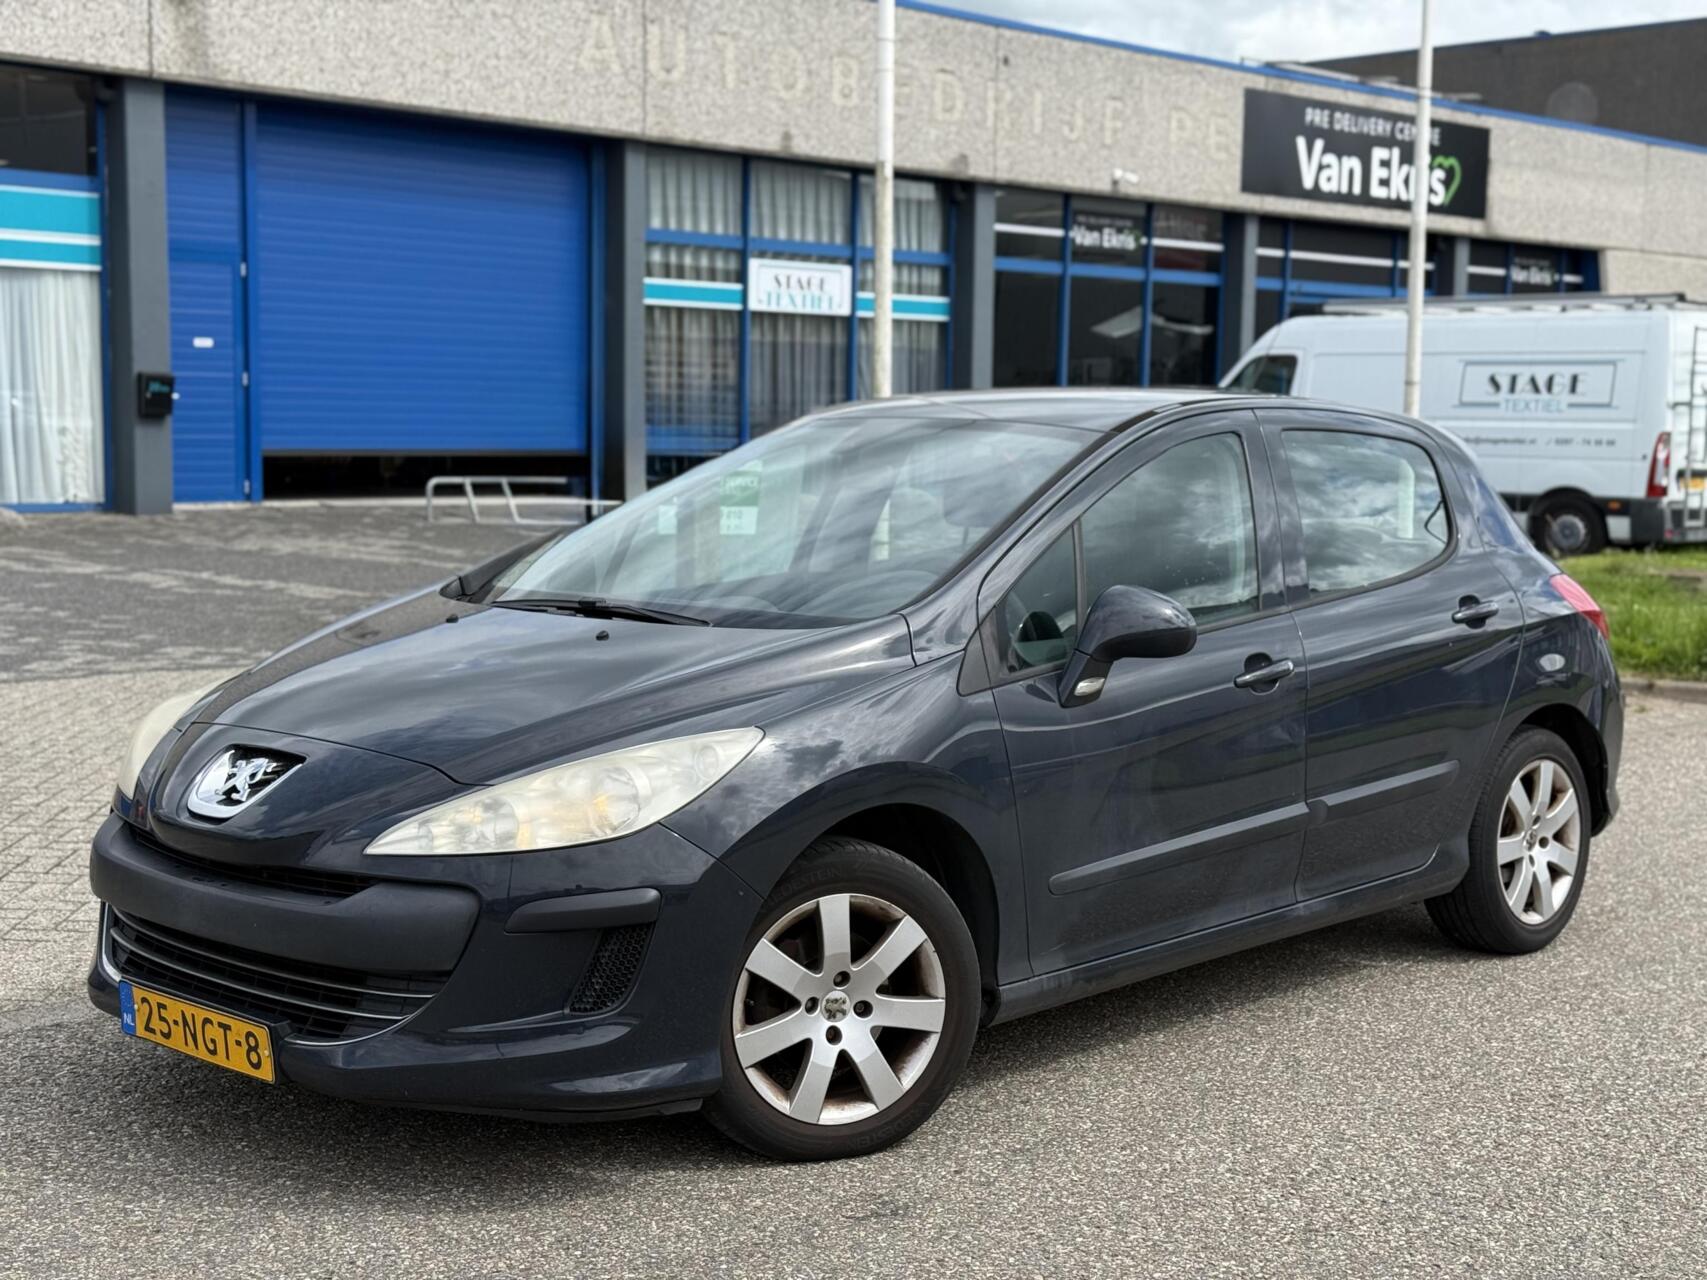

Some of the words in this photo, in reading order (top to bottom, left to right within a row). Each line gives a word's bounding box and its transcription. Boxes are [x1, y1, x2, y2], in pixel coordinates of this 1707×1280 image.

[1305, 107, 1330, 129] PRE
[1333, 112, 1393, 138] DELIVERY
[1295, 135, 1362, 196] Van
[1073, 224, 1100, 247] Van
[1487, 372, 1588, 396] STAGE
[1504, 399, 1564, 413] TEXTIEL
[123, 1012, 135, 1026] NL
[141, 996, 262, 1071] 25-NGT-8
